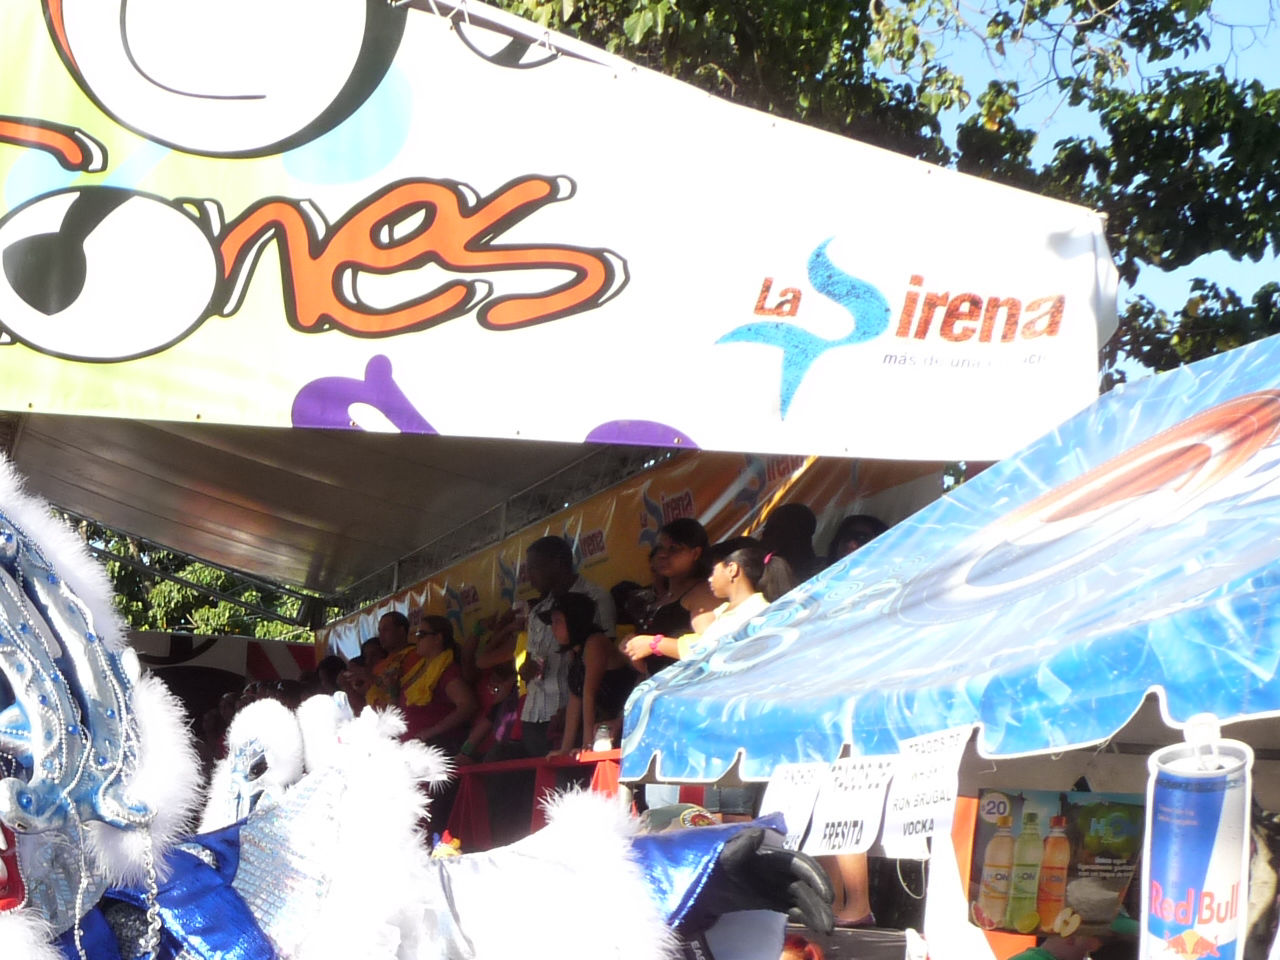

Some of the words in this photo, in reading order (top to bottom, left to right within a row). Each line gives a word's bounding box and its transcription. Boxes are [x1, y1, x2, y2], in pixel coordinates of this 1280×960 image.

[754, 276, 802, 317] La
[820, 819, 864, 850] FRESITA
[1150, 879, 1195, 925] Red
[1197, 880, 1240, 925] Bull
